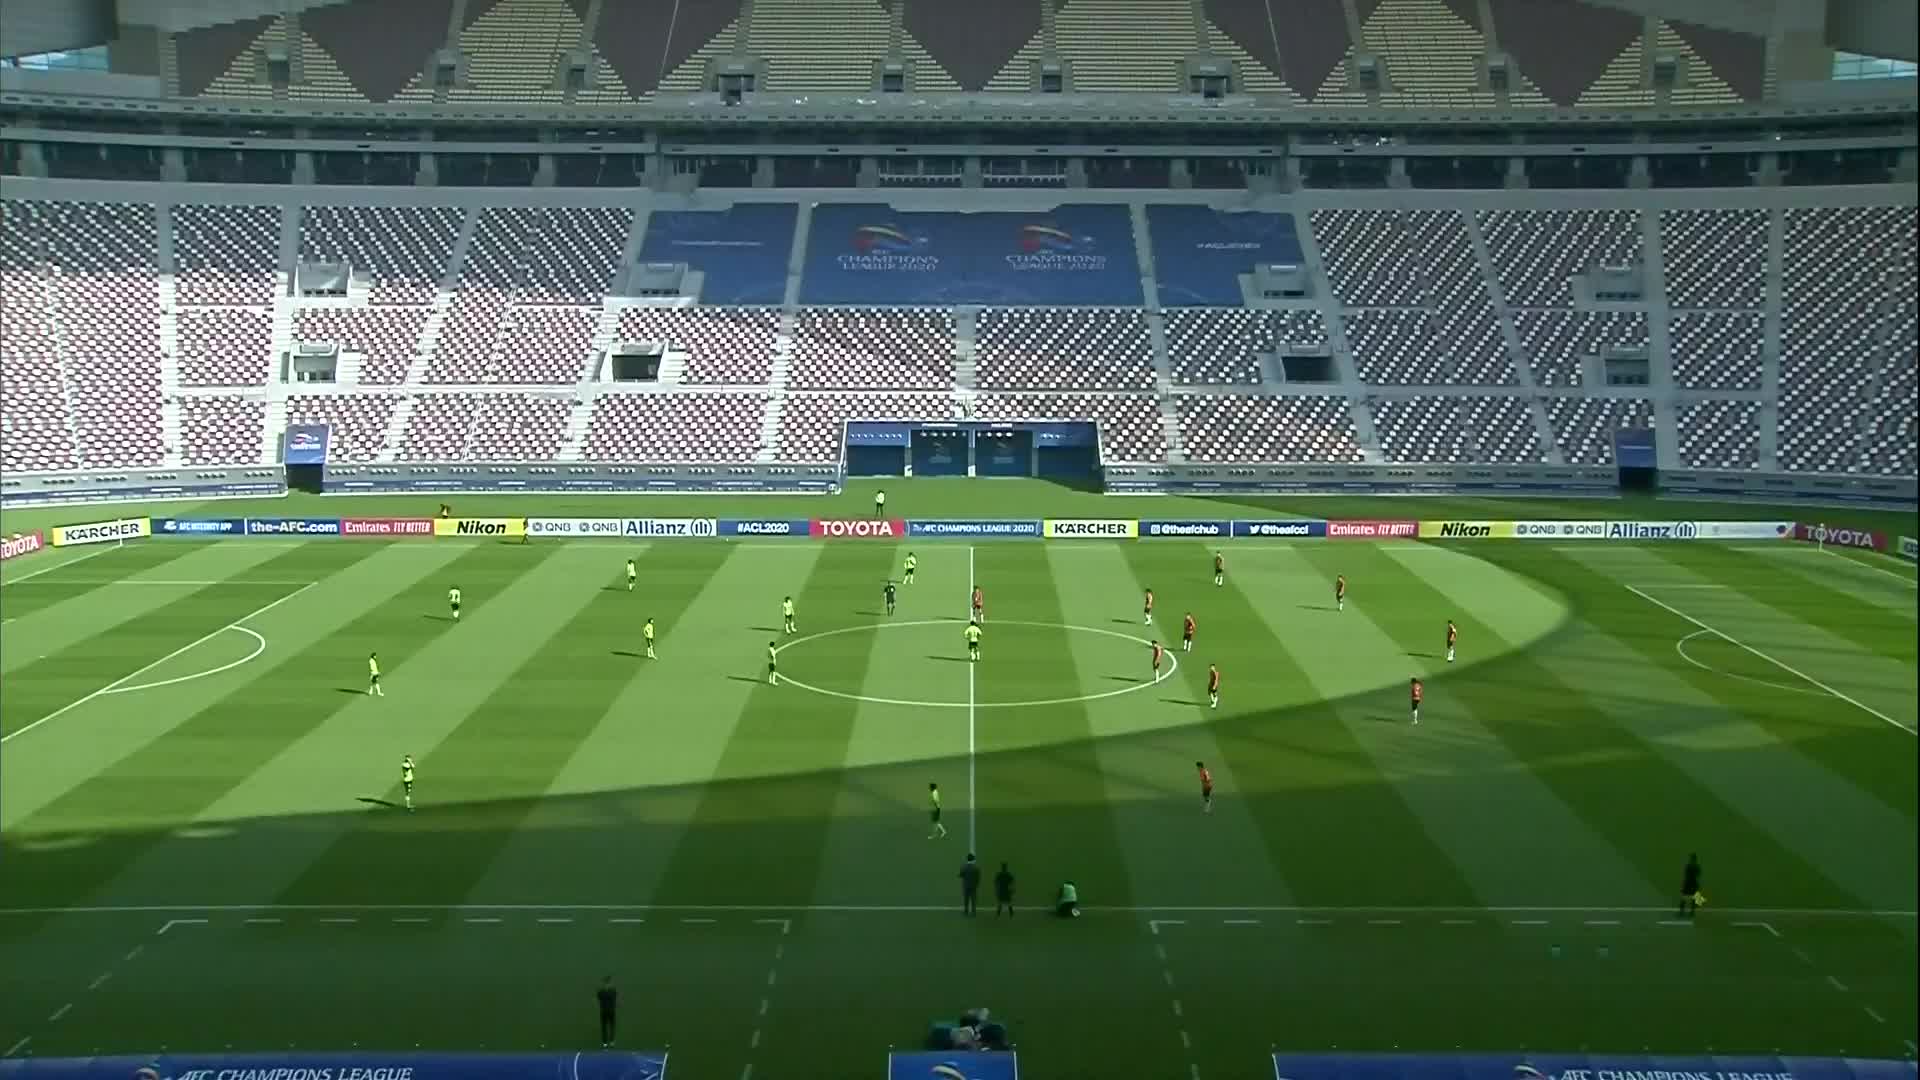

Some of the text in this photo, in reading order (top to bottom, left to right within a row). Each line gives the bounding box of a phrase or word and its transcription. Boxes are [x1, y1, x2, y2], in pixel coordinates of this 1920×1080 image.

[65, 523, 139, 541] KÄRCHER
[251, 522, 337, 533] the-AFC.com
[345, 522, 391, 533] Emirates
[457, 520, 506, 534] Nikon
[545, 522, 618, 532] QNB QNB
[626, 520, 686, 535] Allianz
[737, 520, 789, 533] #ACL2020
[819, 521, 892, 536] TOYOTA
[1013, 524, 1034, 532] 2020
[1054, 523, 1127, 534] KÄRCHER
[1330, 524, 1375, 535] Emirates
[1440, 523, 1490, 537] Nikon
[1529, 525, 1602, 535] QNB QNB
[1610, 523, 1670, 537] Allianz
[1805, 526, 1874, 547] TOYOTA
[217, 1069, 331, 1080] CHAMPIONS
[338, 1068, 412, 1080] LEAGUE
